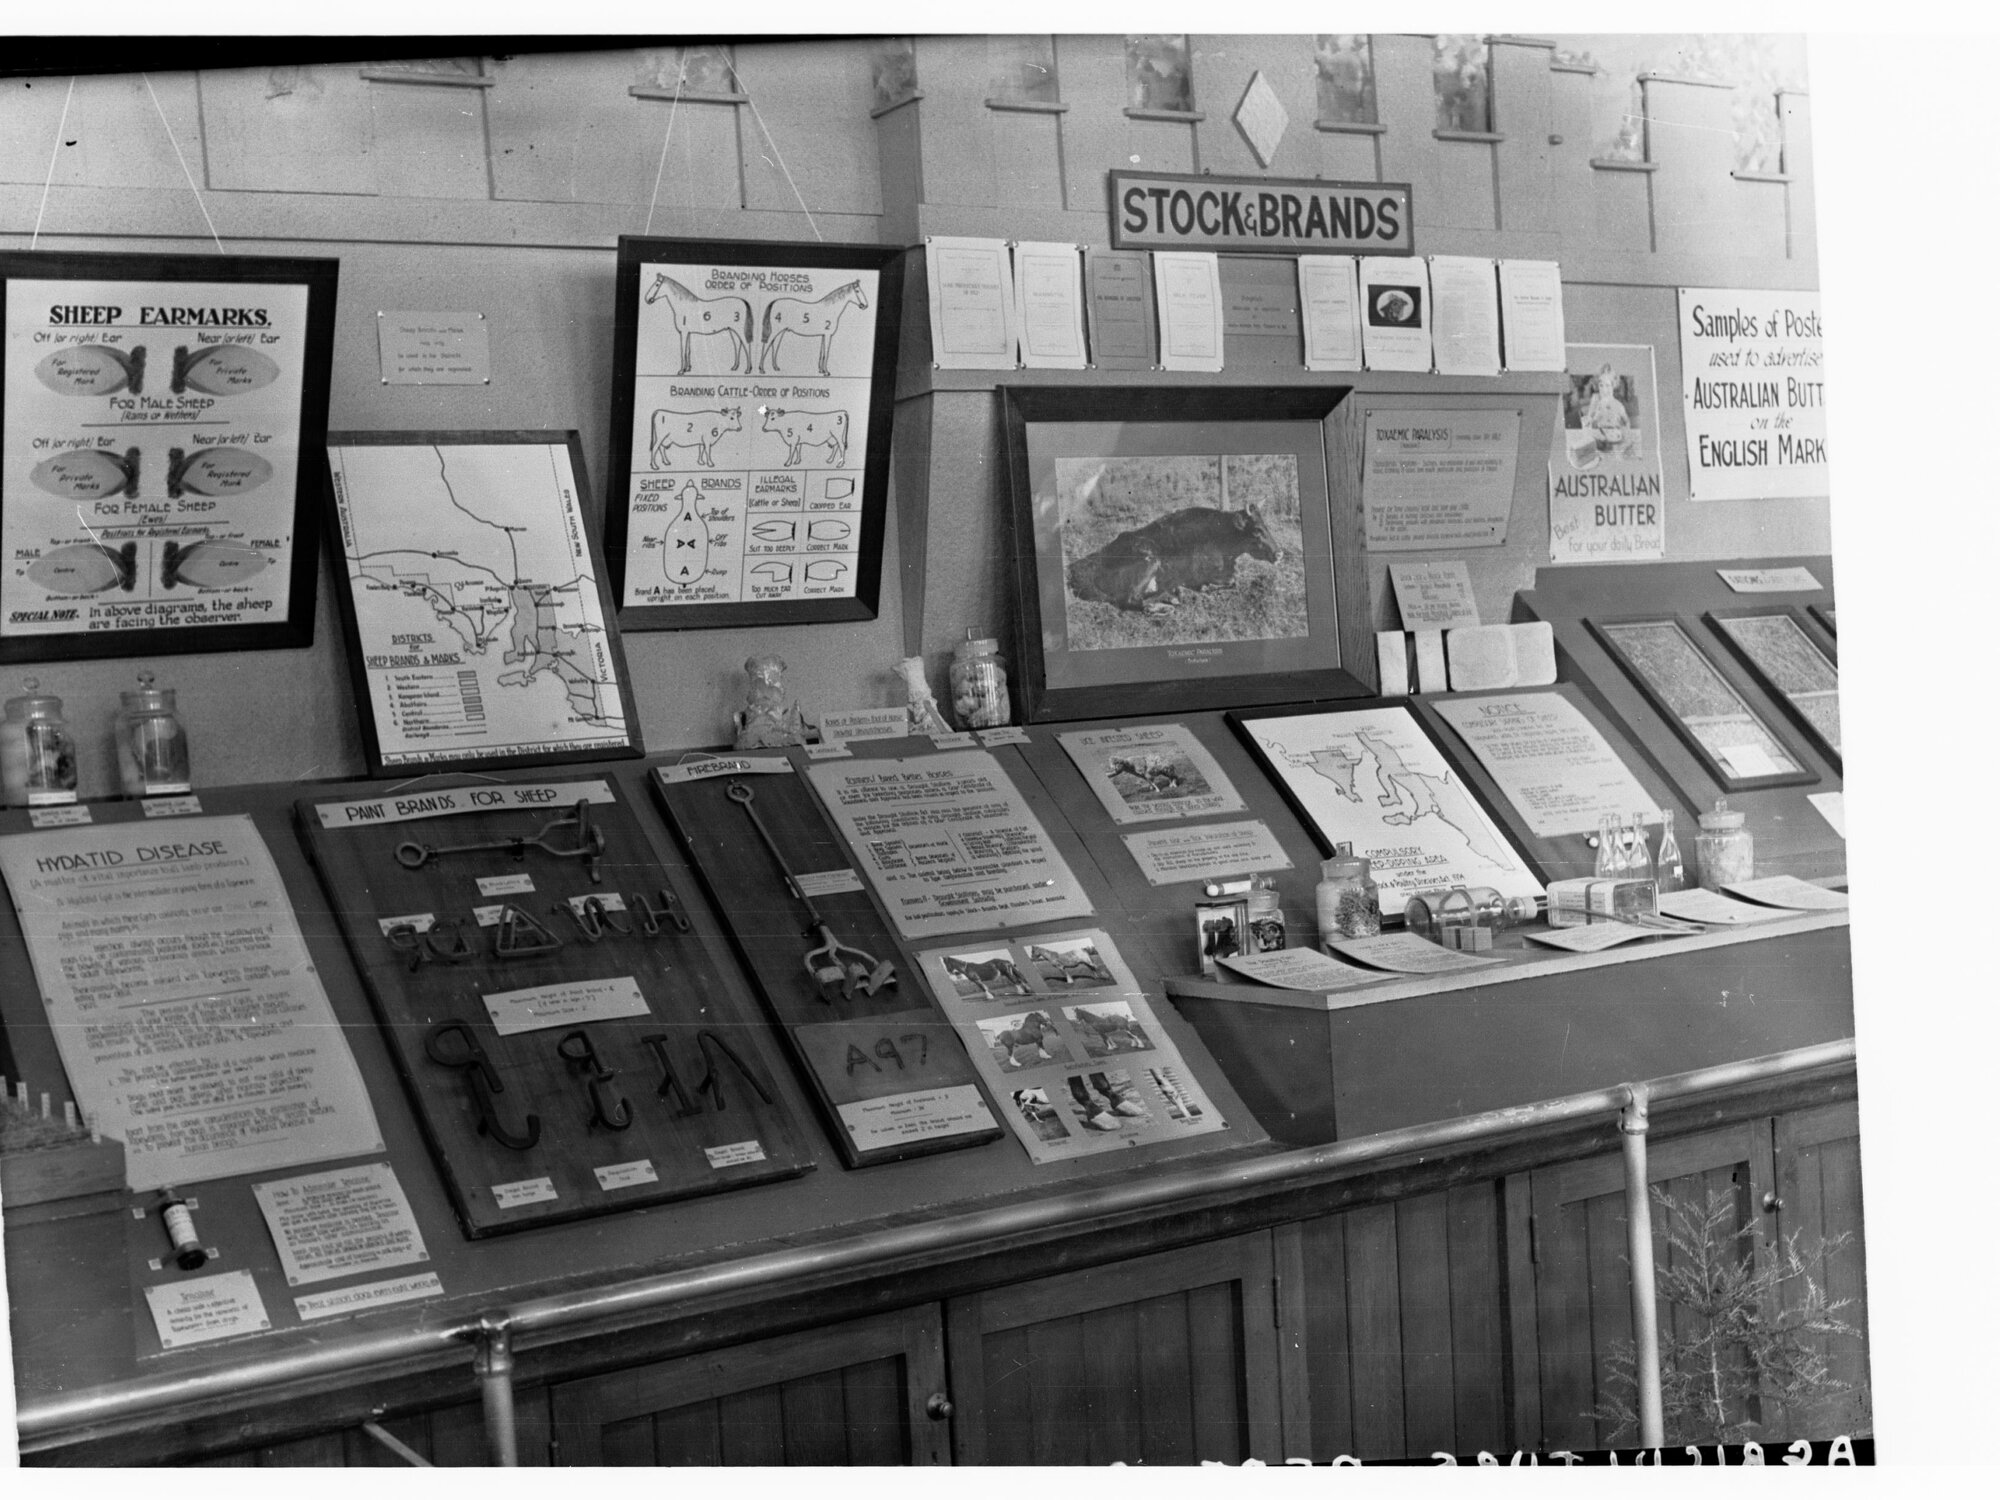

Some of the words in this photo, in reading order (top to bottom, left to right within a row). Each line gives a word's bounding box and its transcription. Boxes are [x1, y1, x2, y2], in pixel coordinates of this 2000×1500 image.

[711, 268, 767, 283] BRANDING
[769, 271, 810, 283] HORSES
[705, 279, 737, 290] ORDER
[759, 281, 813, 293] POSITIONS
[49, 304, 122, 326] SHEEP
[139, 306, 272, 327] EARMARKS.
[703, 311, 711, 322] 6
[733, 311, 740, 322] 3
[774, 312, 782, 323] 4
[802, 312, 810, 324] 5
[824, 319, 832, 331] 2
[1692, 304, 1758, 344] Samples
[1764, 309, 1779, 338] of
[101, 332, 122, 344] Ear
[197, 332, 222, 344] Near
[260, 332, 280, 344] Ear
[1708, 347, 1742, 367] used
[1745, 348, 1760, 367] to
[670, 385, 715, 397] BRANDING
[792, 387, 830, 398] POSITIONS
[1693, 376, 1780, 410] AUSTRALIAN
[110, 396, 136, 410] FOR
[140, 396, 176, 410] MALE
[176, 397, 215, 409] SHEEP
[836, 415, 843, 425] 3
[1750, 417, 1769, 431] on
[1773, 410, 1794, 430] the
[686, 423, 694, 433] 2
[711, 427, 719, 437] 6
[786, 427, 793, 437] 5
[806, 423, 813, 433] 4
[1698, 433, 1768, 468] ENGLISH
[640, 478, 676, 490] SHEEP
[701, 478, 742, 489] BRANDS
[760, 475, 796, 484] ILLEGAL
[1554, 473, 1660, 498] AUSTRALIAN
[755, 484, 797, 493] EARMARKS
[634, 493, 660, 502] FIXED
[94, 503, 121, 515] FOR
[123, 502, 171, 514] FEMALE
[177, 500, 217, 513] SHEEP
[632, 503, 668, 513] POSITIONS
[1595, 503, 1656, 526] BUTTER
[15, 548, 41, 559] MALE
[88, 605, 102, 617] In
[103, 603, 145, 617] above
[148, 602, 208, 617] diagrams,
[212, 600, 233, 613] the
[235, 598, 273, 614] sheep
[89, 619, 111, 631] are
[115, 616, 154, 631] facing
[159, 614, 181, 627] the
[184, 612, 242, 625] observer.
[344, 802, 388, 822] PAINT
[394, 794, 456, 817] BRANDS
[469, 790, 505, 807] FOR
[513, 788, 557, 805] SHEEP
[36, 850, 124, 873] HYDATID
[136, 840, 228, 862] DISEASE
[845, 1032, 928, 1078] A97
